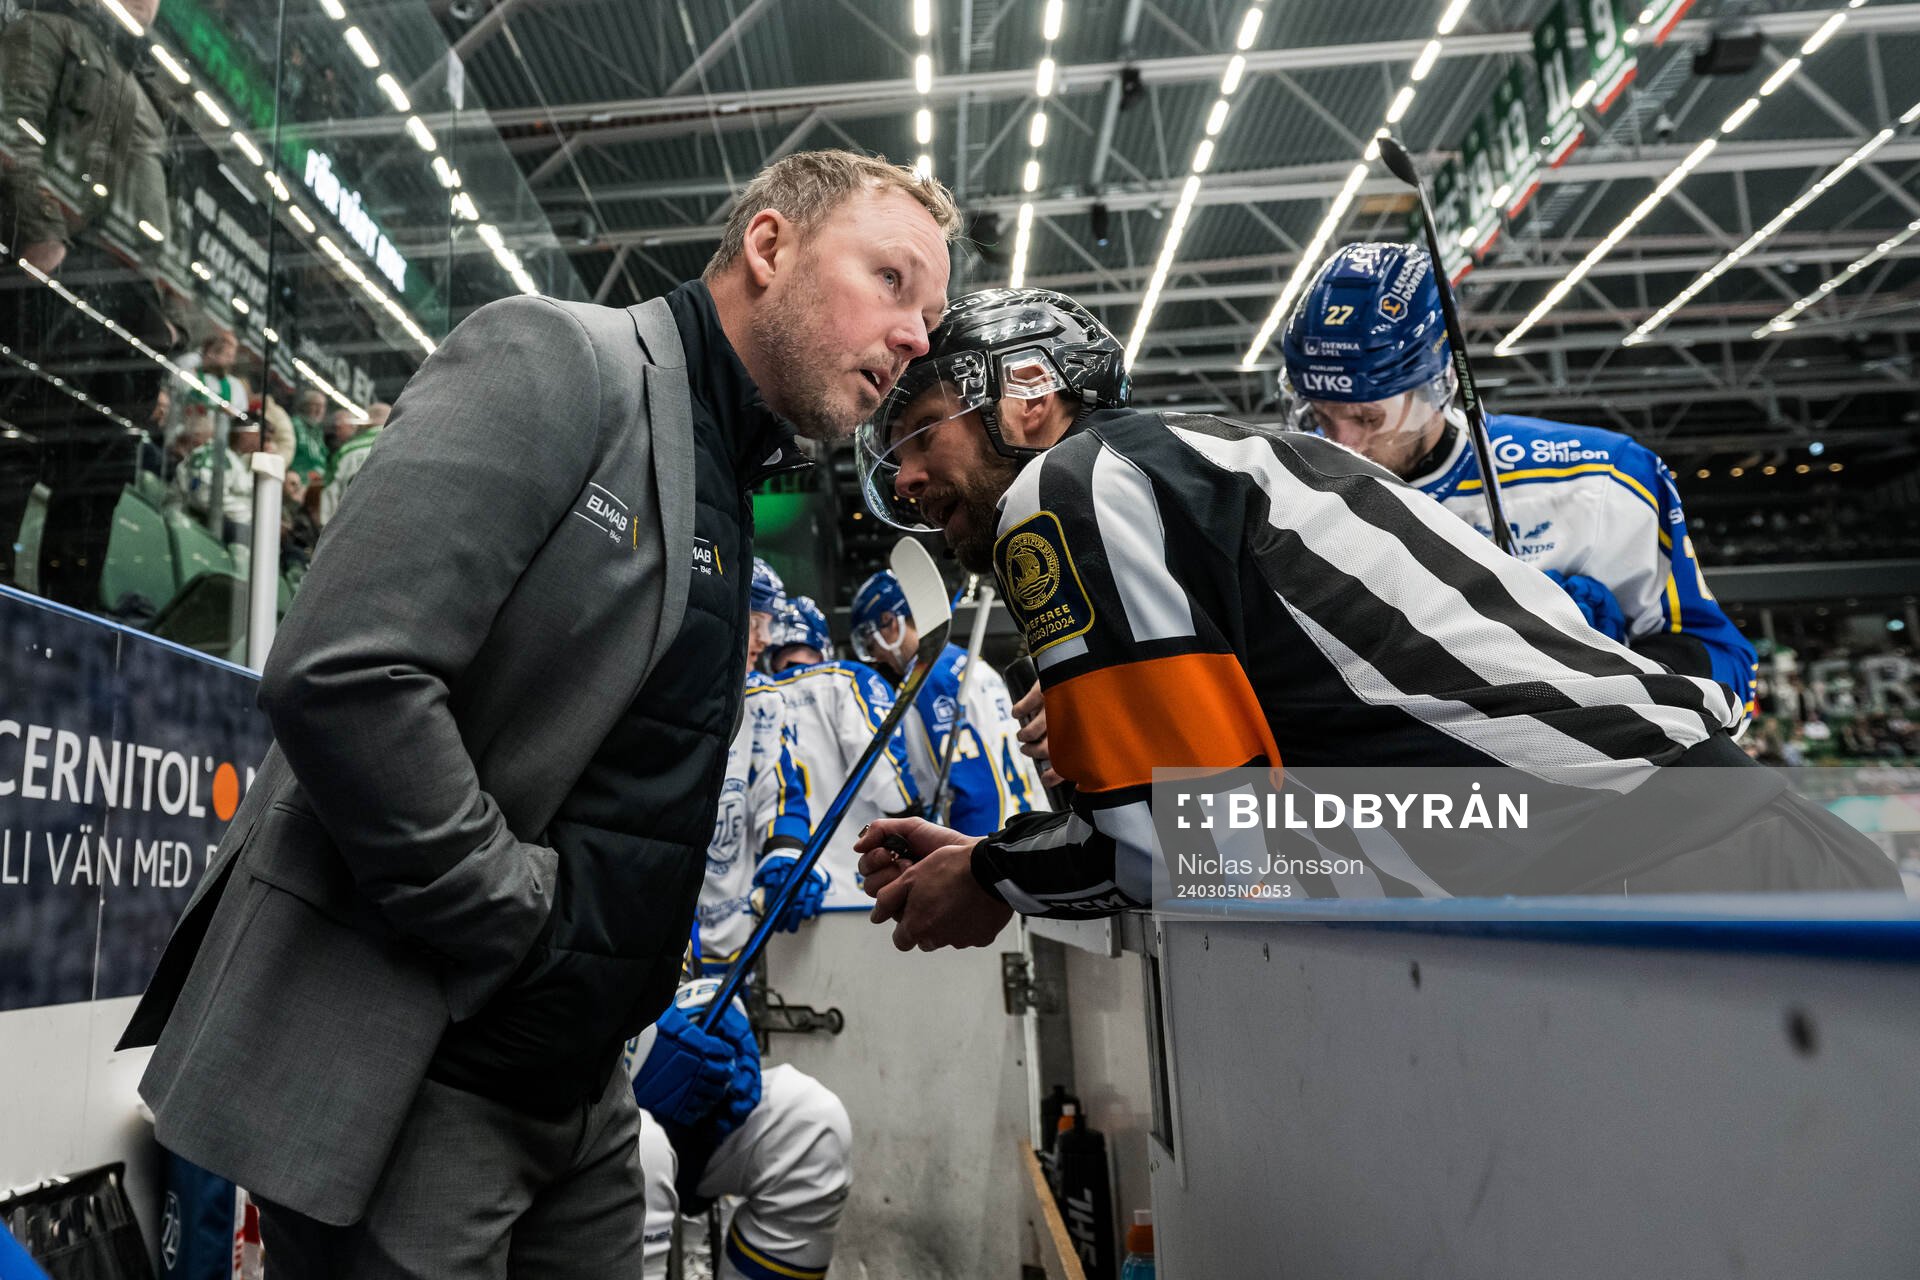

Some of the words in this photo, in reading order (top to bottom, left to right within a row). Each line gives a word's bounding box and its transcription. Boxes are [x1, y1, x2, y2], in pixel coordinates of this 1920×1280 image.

[1324, 305, 1354, 326] 27
[1321, 341, 1360, 350] SVENSKA
[1303, 373, 1353, 393] LYKO
[1531, 439, 1581, 451] Clas
[1532, 449, 1609, 463] Ohlson
[586, 494, 628, 532] ELMAB
[692, 546, 712, 563] MAB
[1026, 603, 1071, 632] REFEREE
[2, 829, 32, 884] LI
[46, 824, 122, 887] VÄN
[133, 839, 193, 888] MED
